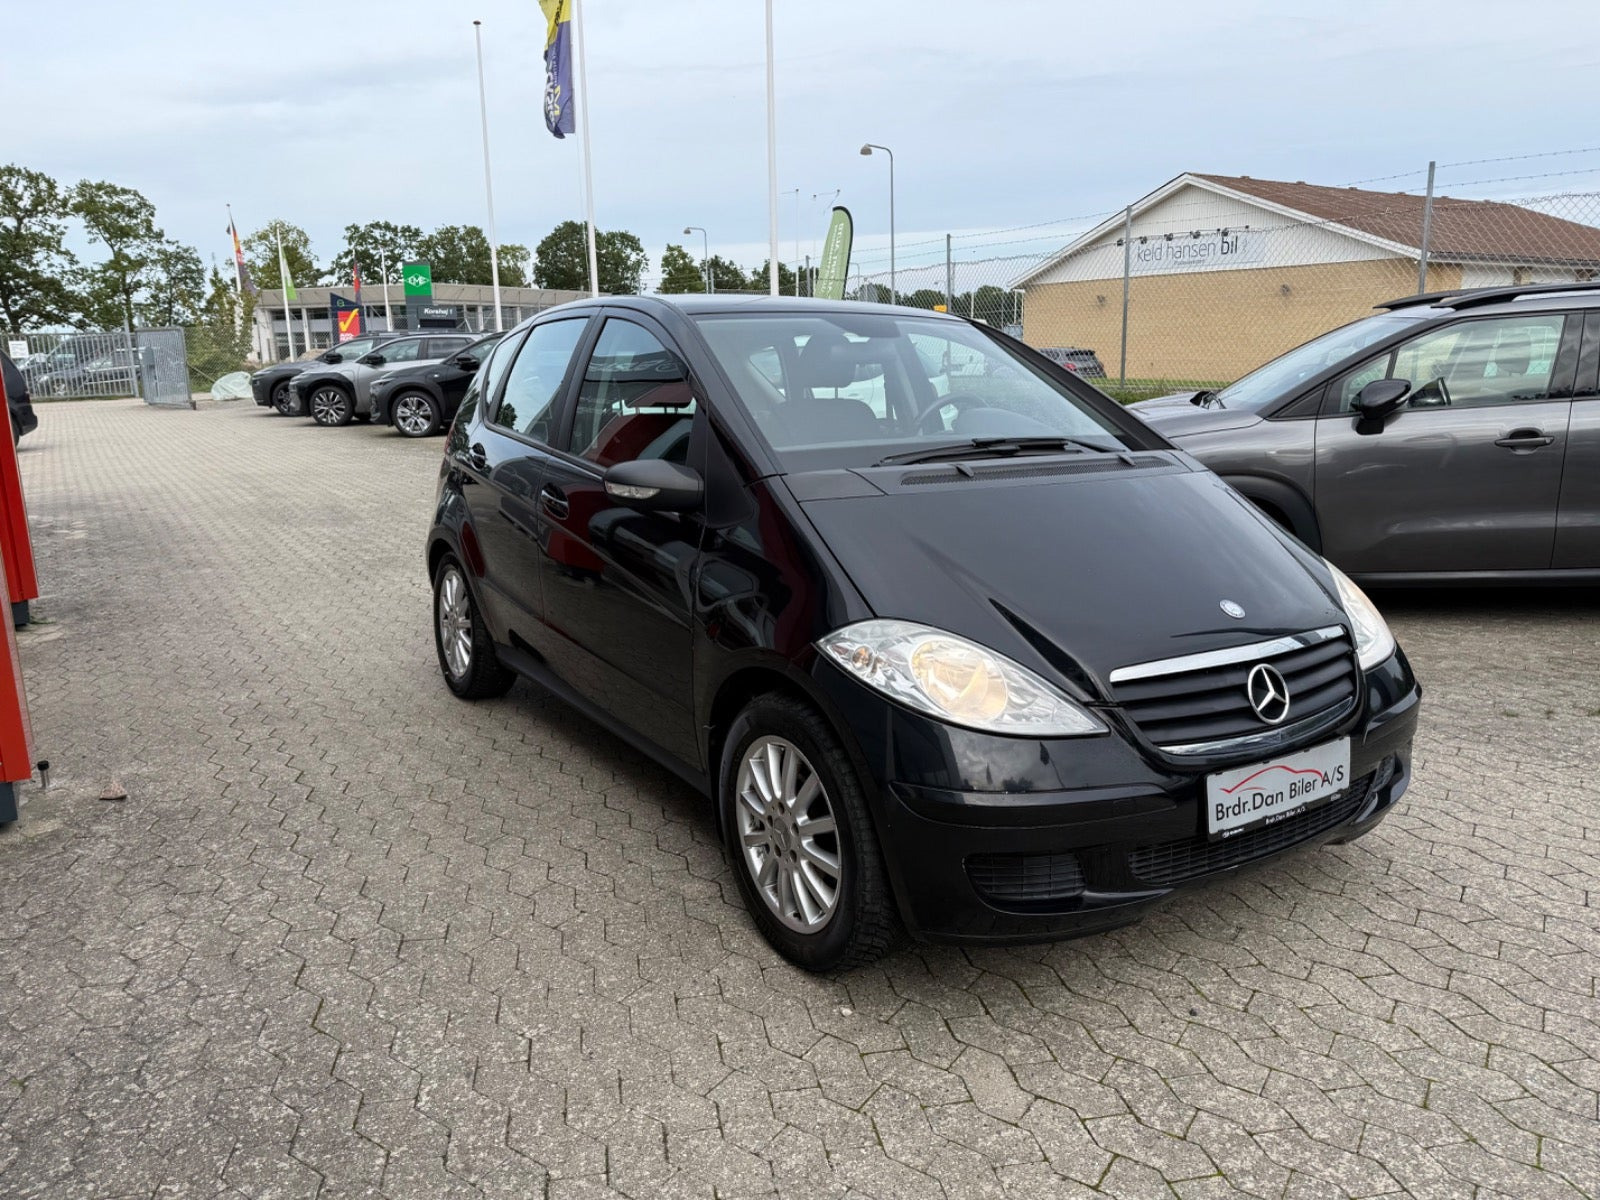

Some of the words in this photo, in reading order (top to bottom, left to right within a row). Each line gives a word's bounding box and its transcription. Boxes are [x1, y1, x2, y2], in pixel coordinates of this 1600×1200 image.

[1137, 243, 1162, 262] keld
[1166, 241, 1216, 260] hansen
[1221, 235, 1238, 255] bil
[1289, 777, 1318, 799] Biler
[1321, 764, 1344, 788] A/S
